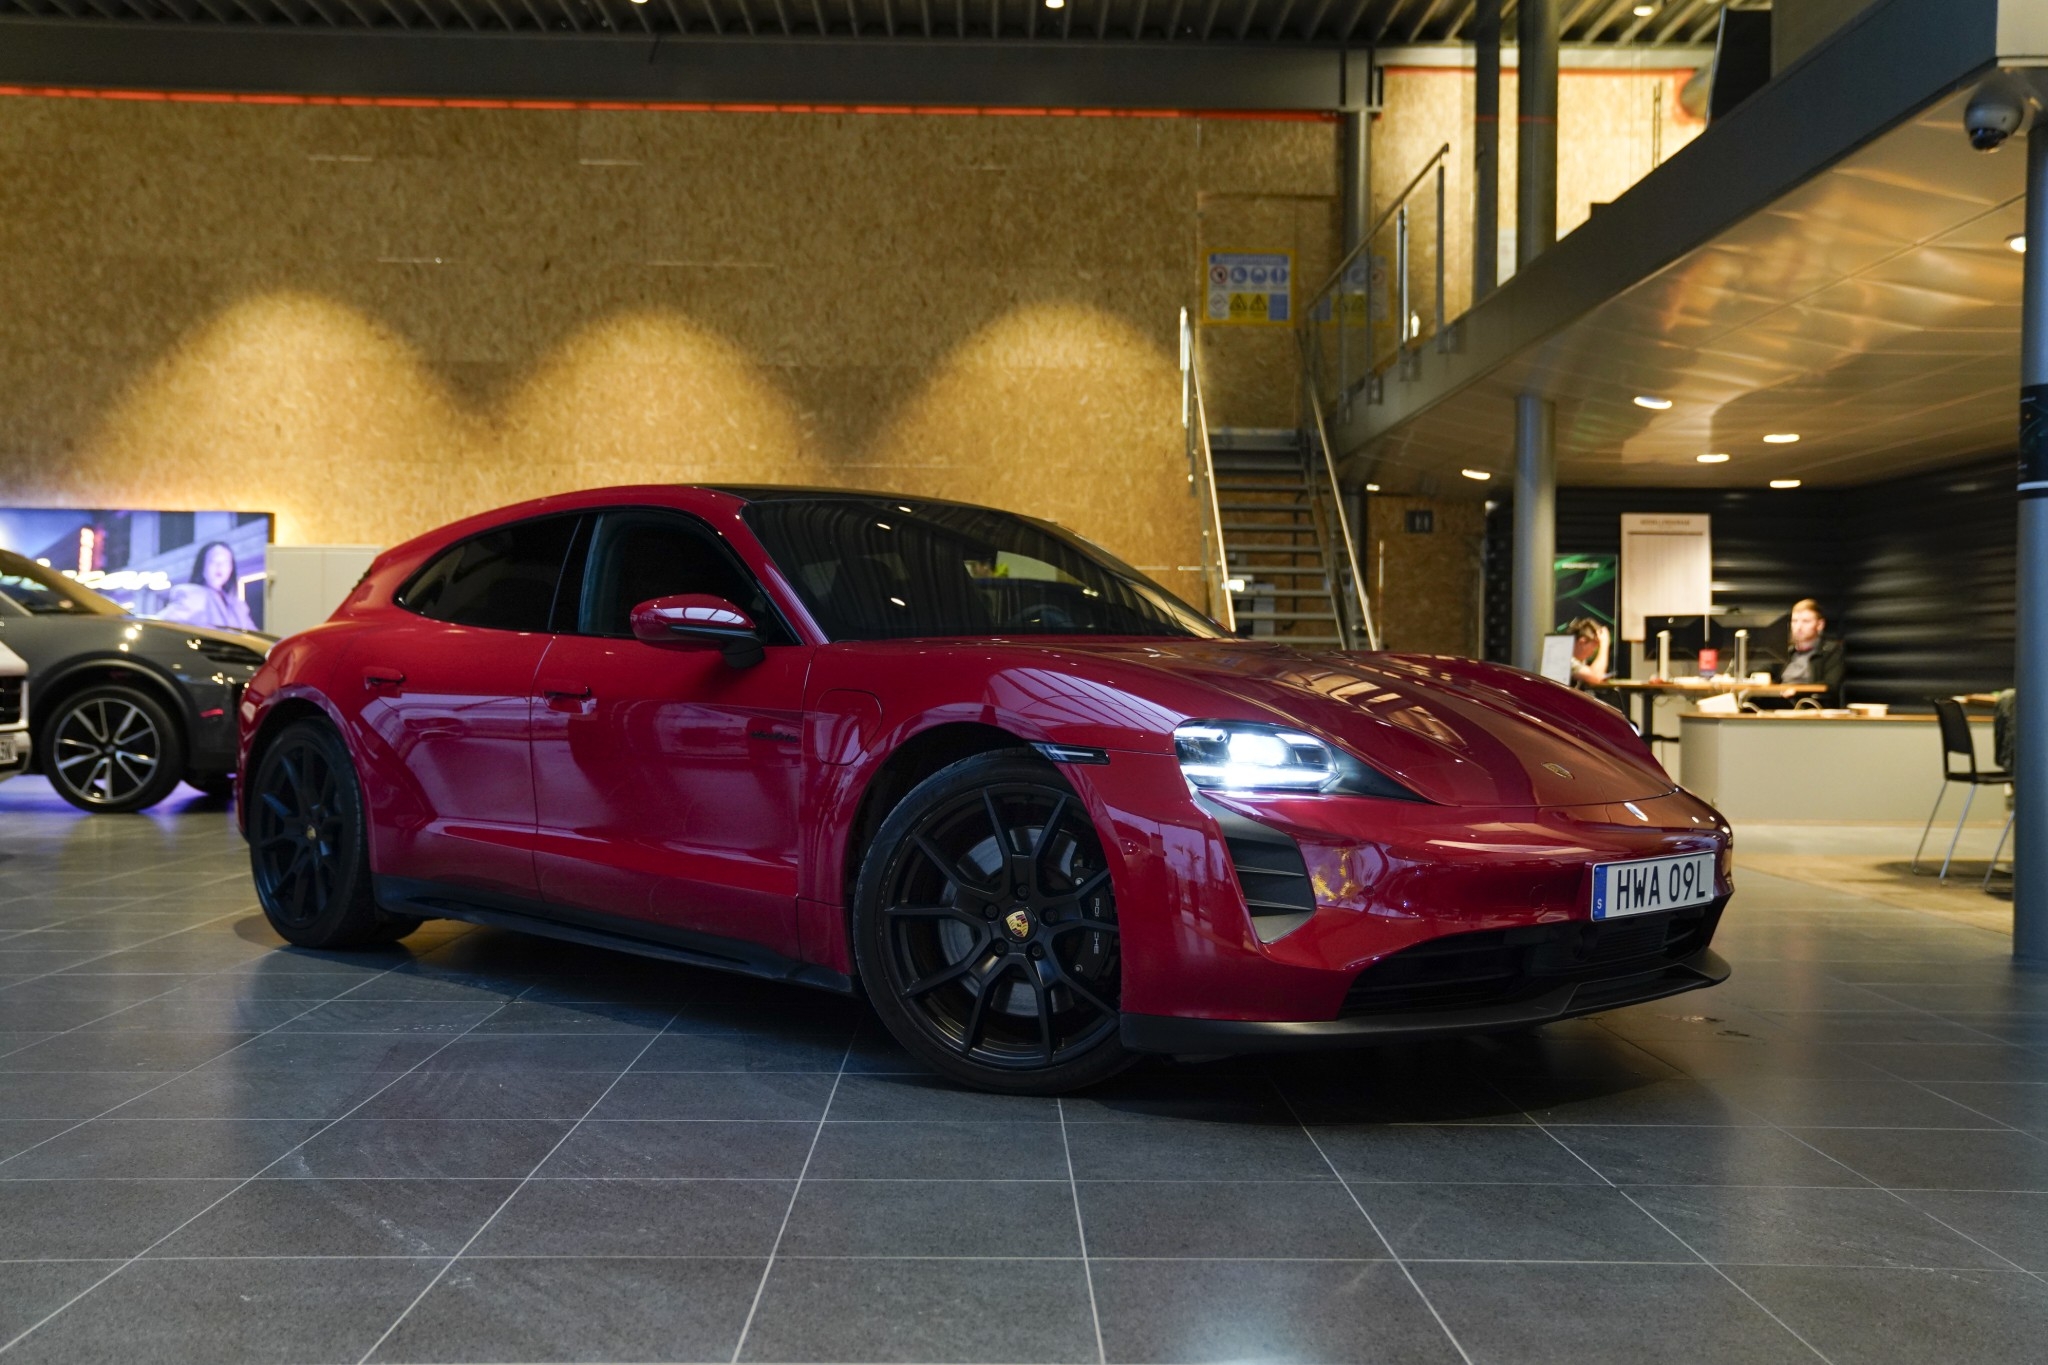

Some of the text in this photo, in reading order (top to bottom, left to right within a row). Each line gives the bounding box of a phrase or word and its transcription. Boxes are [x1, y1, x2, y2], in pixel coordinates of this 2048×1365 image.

[1616, 860, 1706, 910] HWA 09L
[1596, 898, 1603, 910] S
